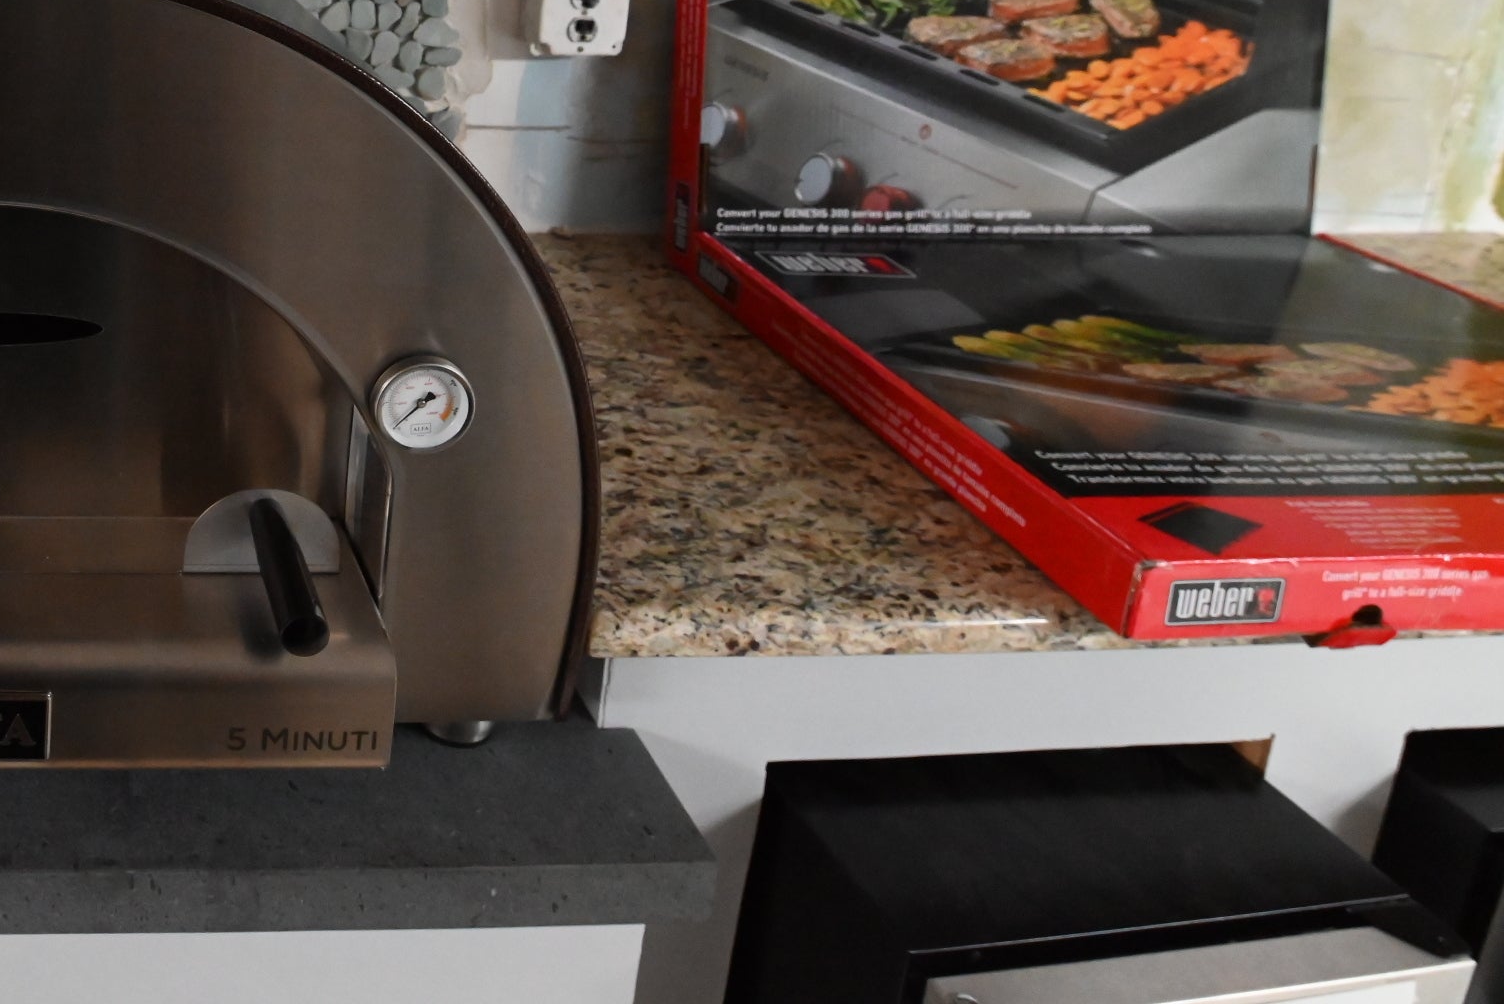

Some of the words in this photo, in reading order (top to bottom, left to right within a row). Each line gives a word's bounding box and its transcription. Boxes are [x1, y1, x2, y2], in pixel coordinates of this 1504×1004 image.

[1176, 583, 1254, 619] weber
[227, 729, 247, 750] 5
[260, 727, 378, 751] MINUTI
